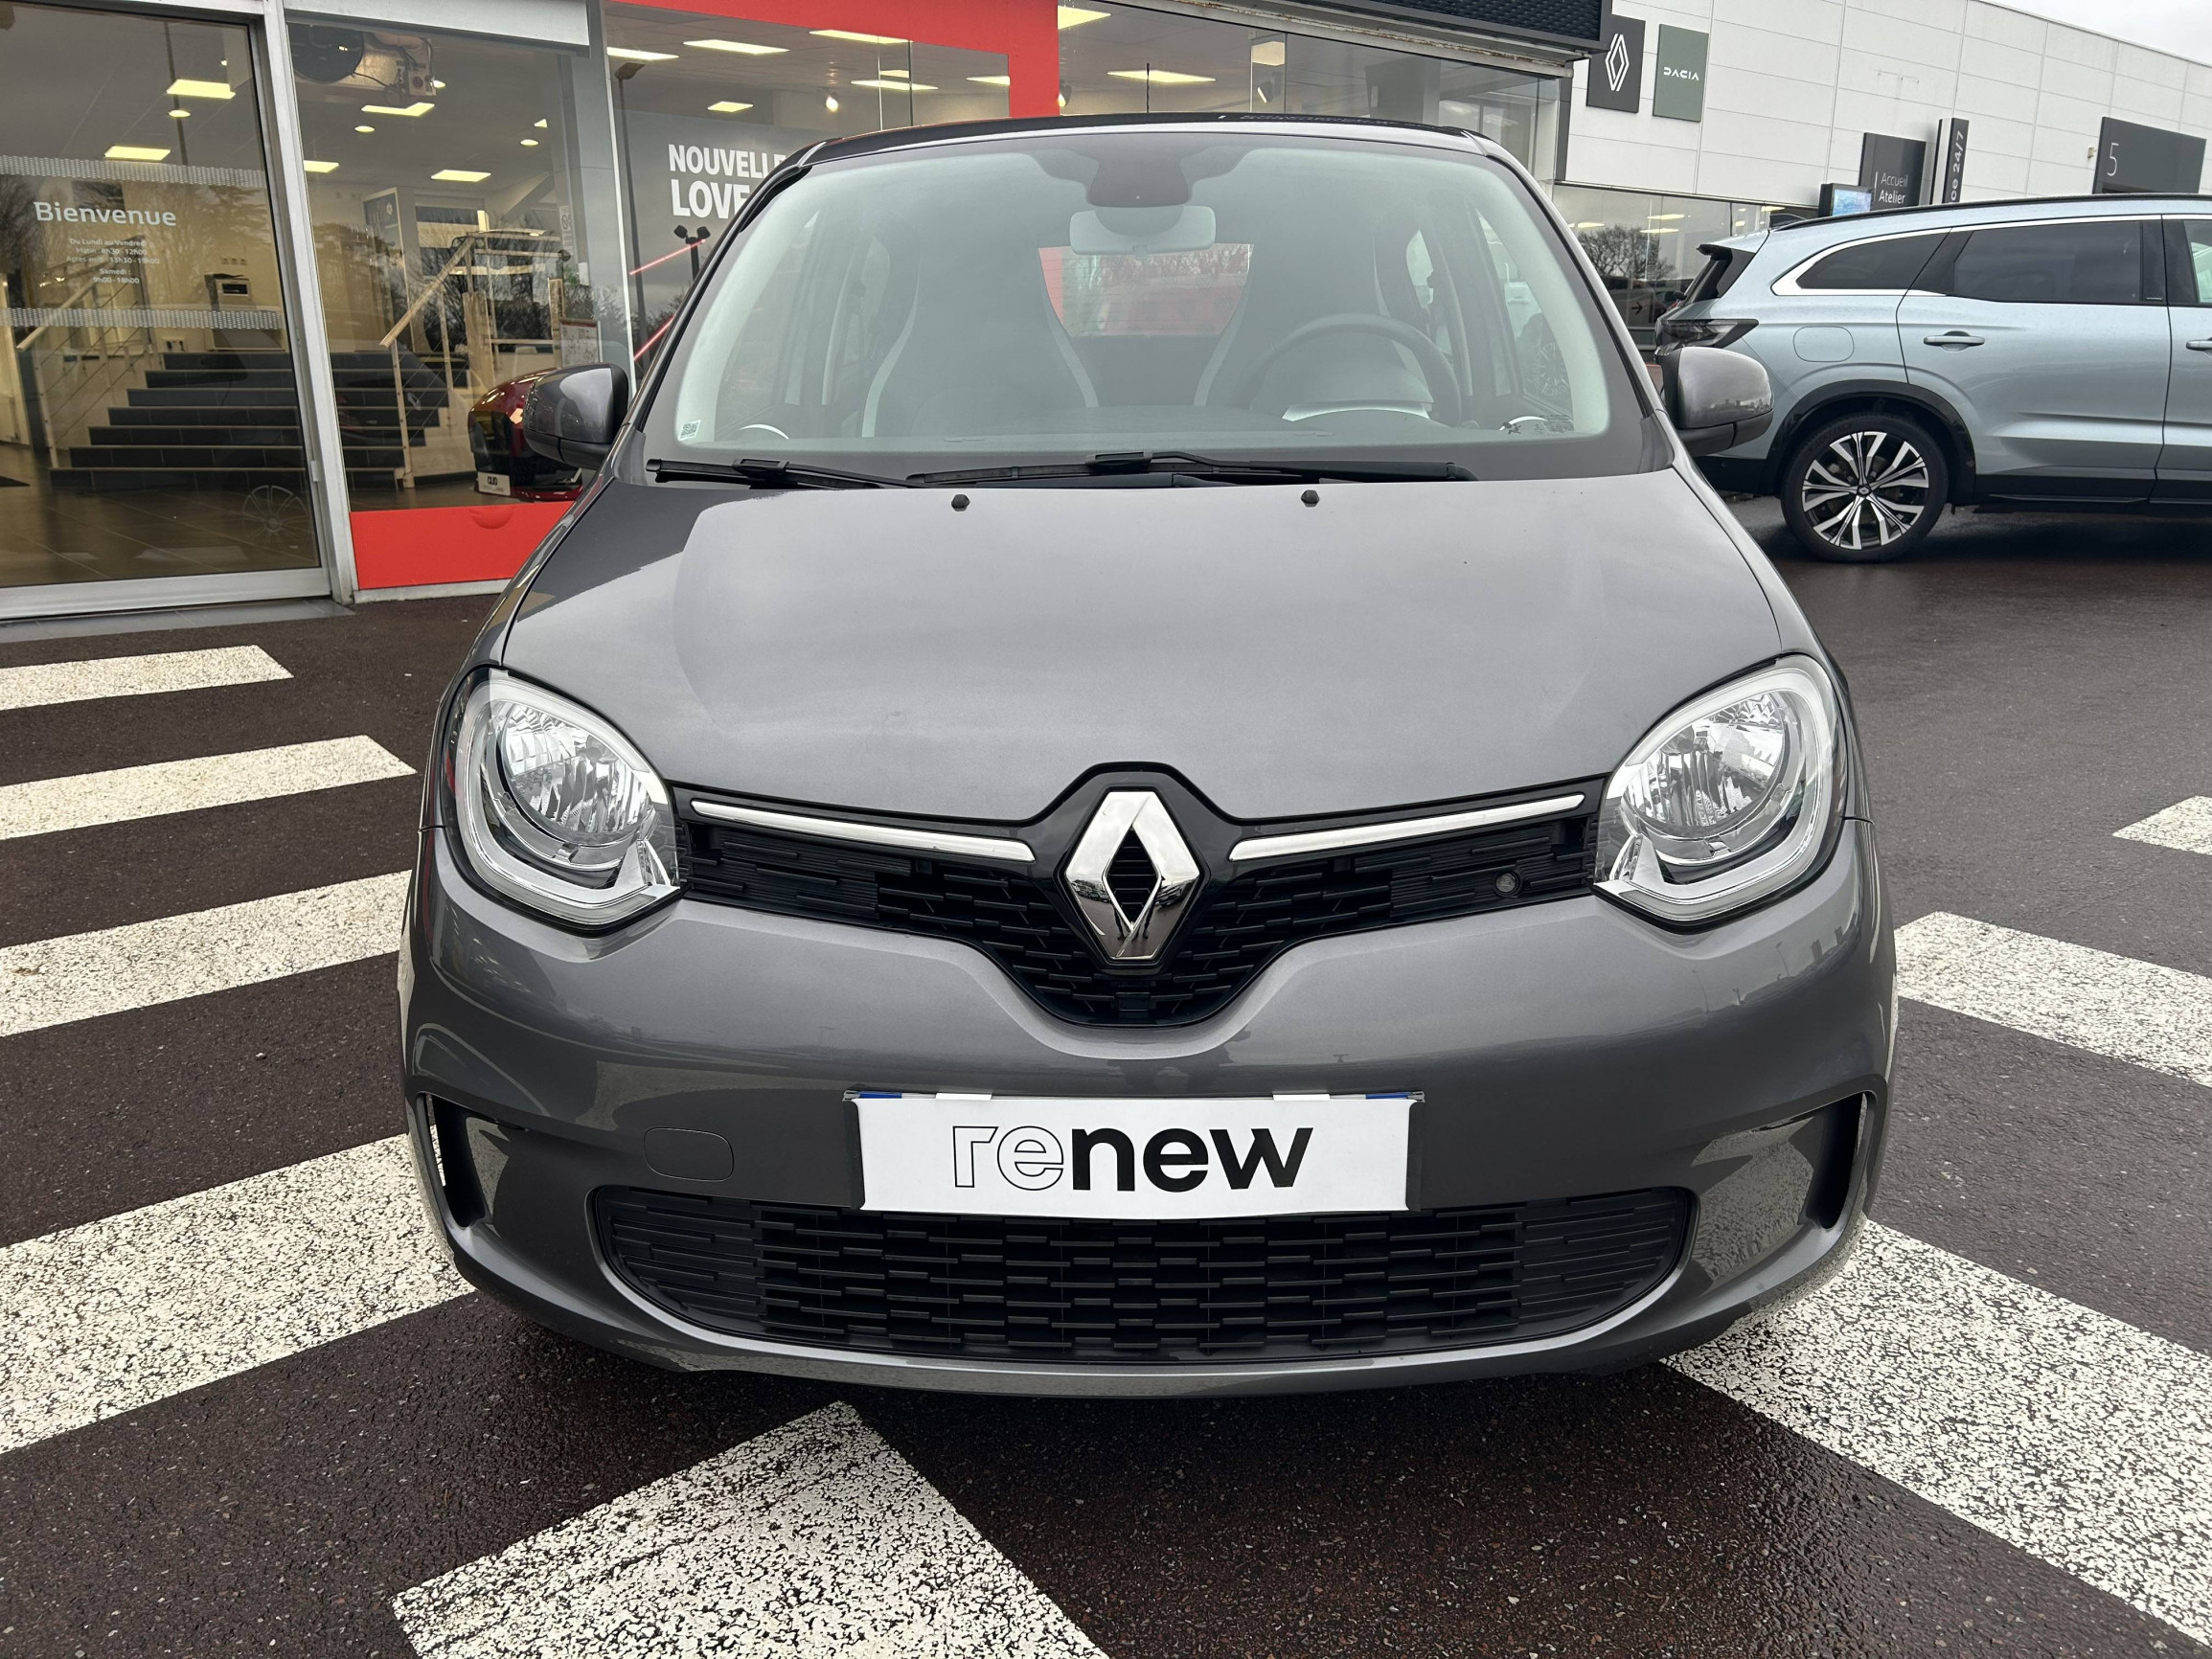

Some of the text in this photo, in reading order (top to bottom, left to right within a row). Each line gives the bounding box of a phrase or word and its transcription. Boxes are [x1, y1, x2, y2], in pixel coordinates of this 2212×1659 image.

[1663, 66, 1699, 81] DACIA
[1952, 130, 1964, 173] 24/7
[2107, 142, 2119, 176] 5
[1881, 172, 1908, 188] Accueil
[1879, 189, 1906, 204] Atelier
[33, 201, 177, 227] Bienvenue
[81, 238, 103, 246] Lundi
[114, 239, 148, 247] Vendredi
[951, 1125, 1313, 1193] renew
